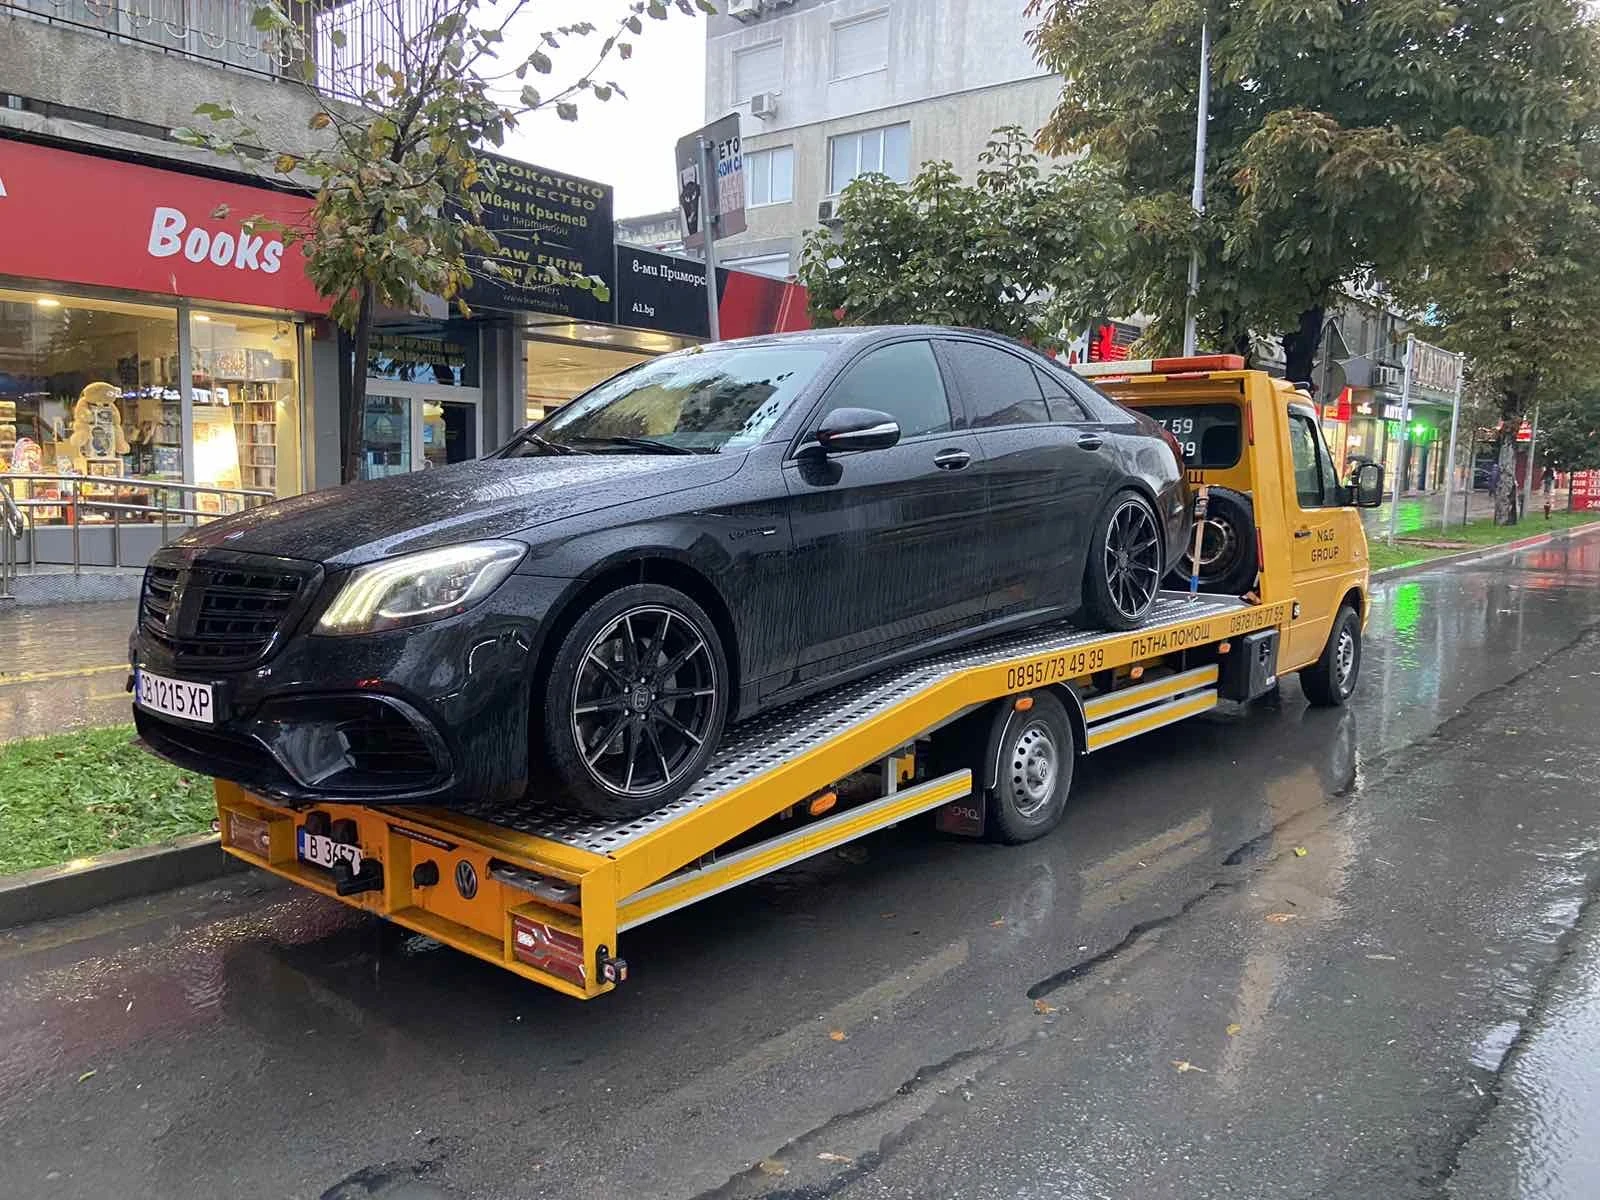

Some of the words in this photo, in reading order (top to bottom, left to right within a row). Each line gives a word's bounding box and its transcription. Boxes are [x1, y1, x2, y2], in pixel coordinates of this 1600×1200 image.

[501, 177, 595, 210] УЖЕСТВО
[492, 247, 530, 261] AW
[537, 254, 583, 272] FIRM
[660, 264, 707, 287] Приморс
[1172, 418, 1193, 434] 59
[1316, 528, 1335, 543] N&G
[1312, 546, 1339, 562] GROUP
[1131, 633, 1168, 658] ПЪТНА
[1170, 623, 1210, 649] ПОМОЩ
[1007, 657, 1065, 690] 0895/73
[1069, 652, 1085, 674] 49
[1089, 648, 1104, 670] 39
[154, 679, 185, 712] 1215
